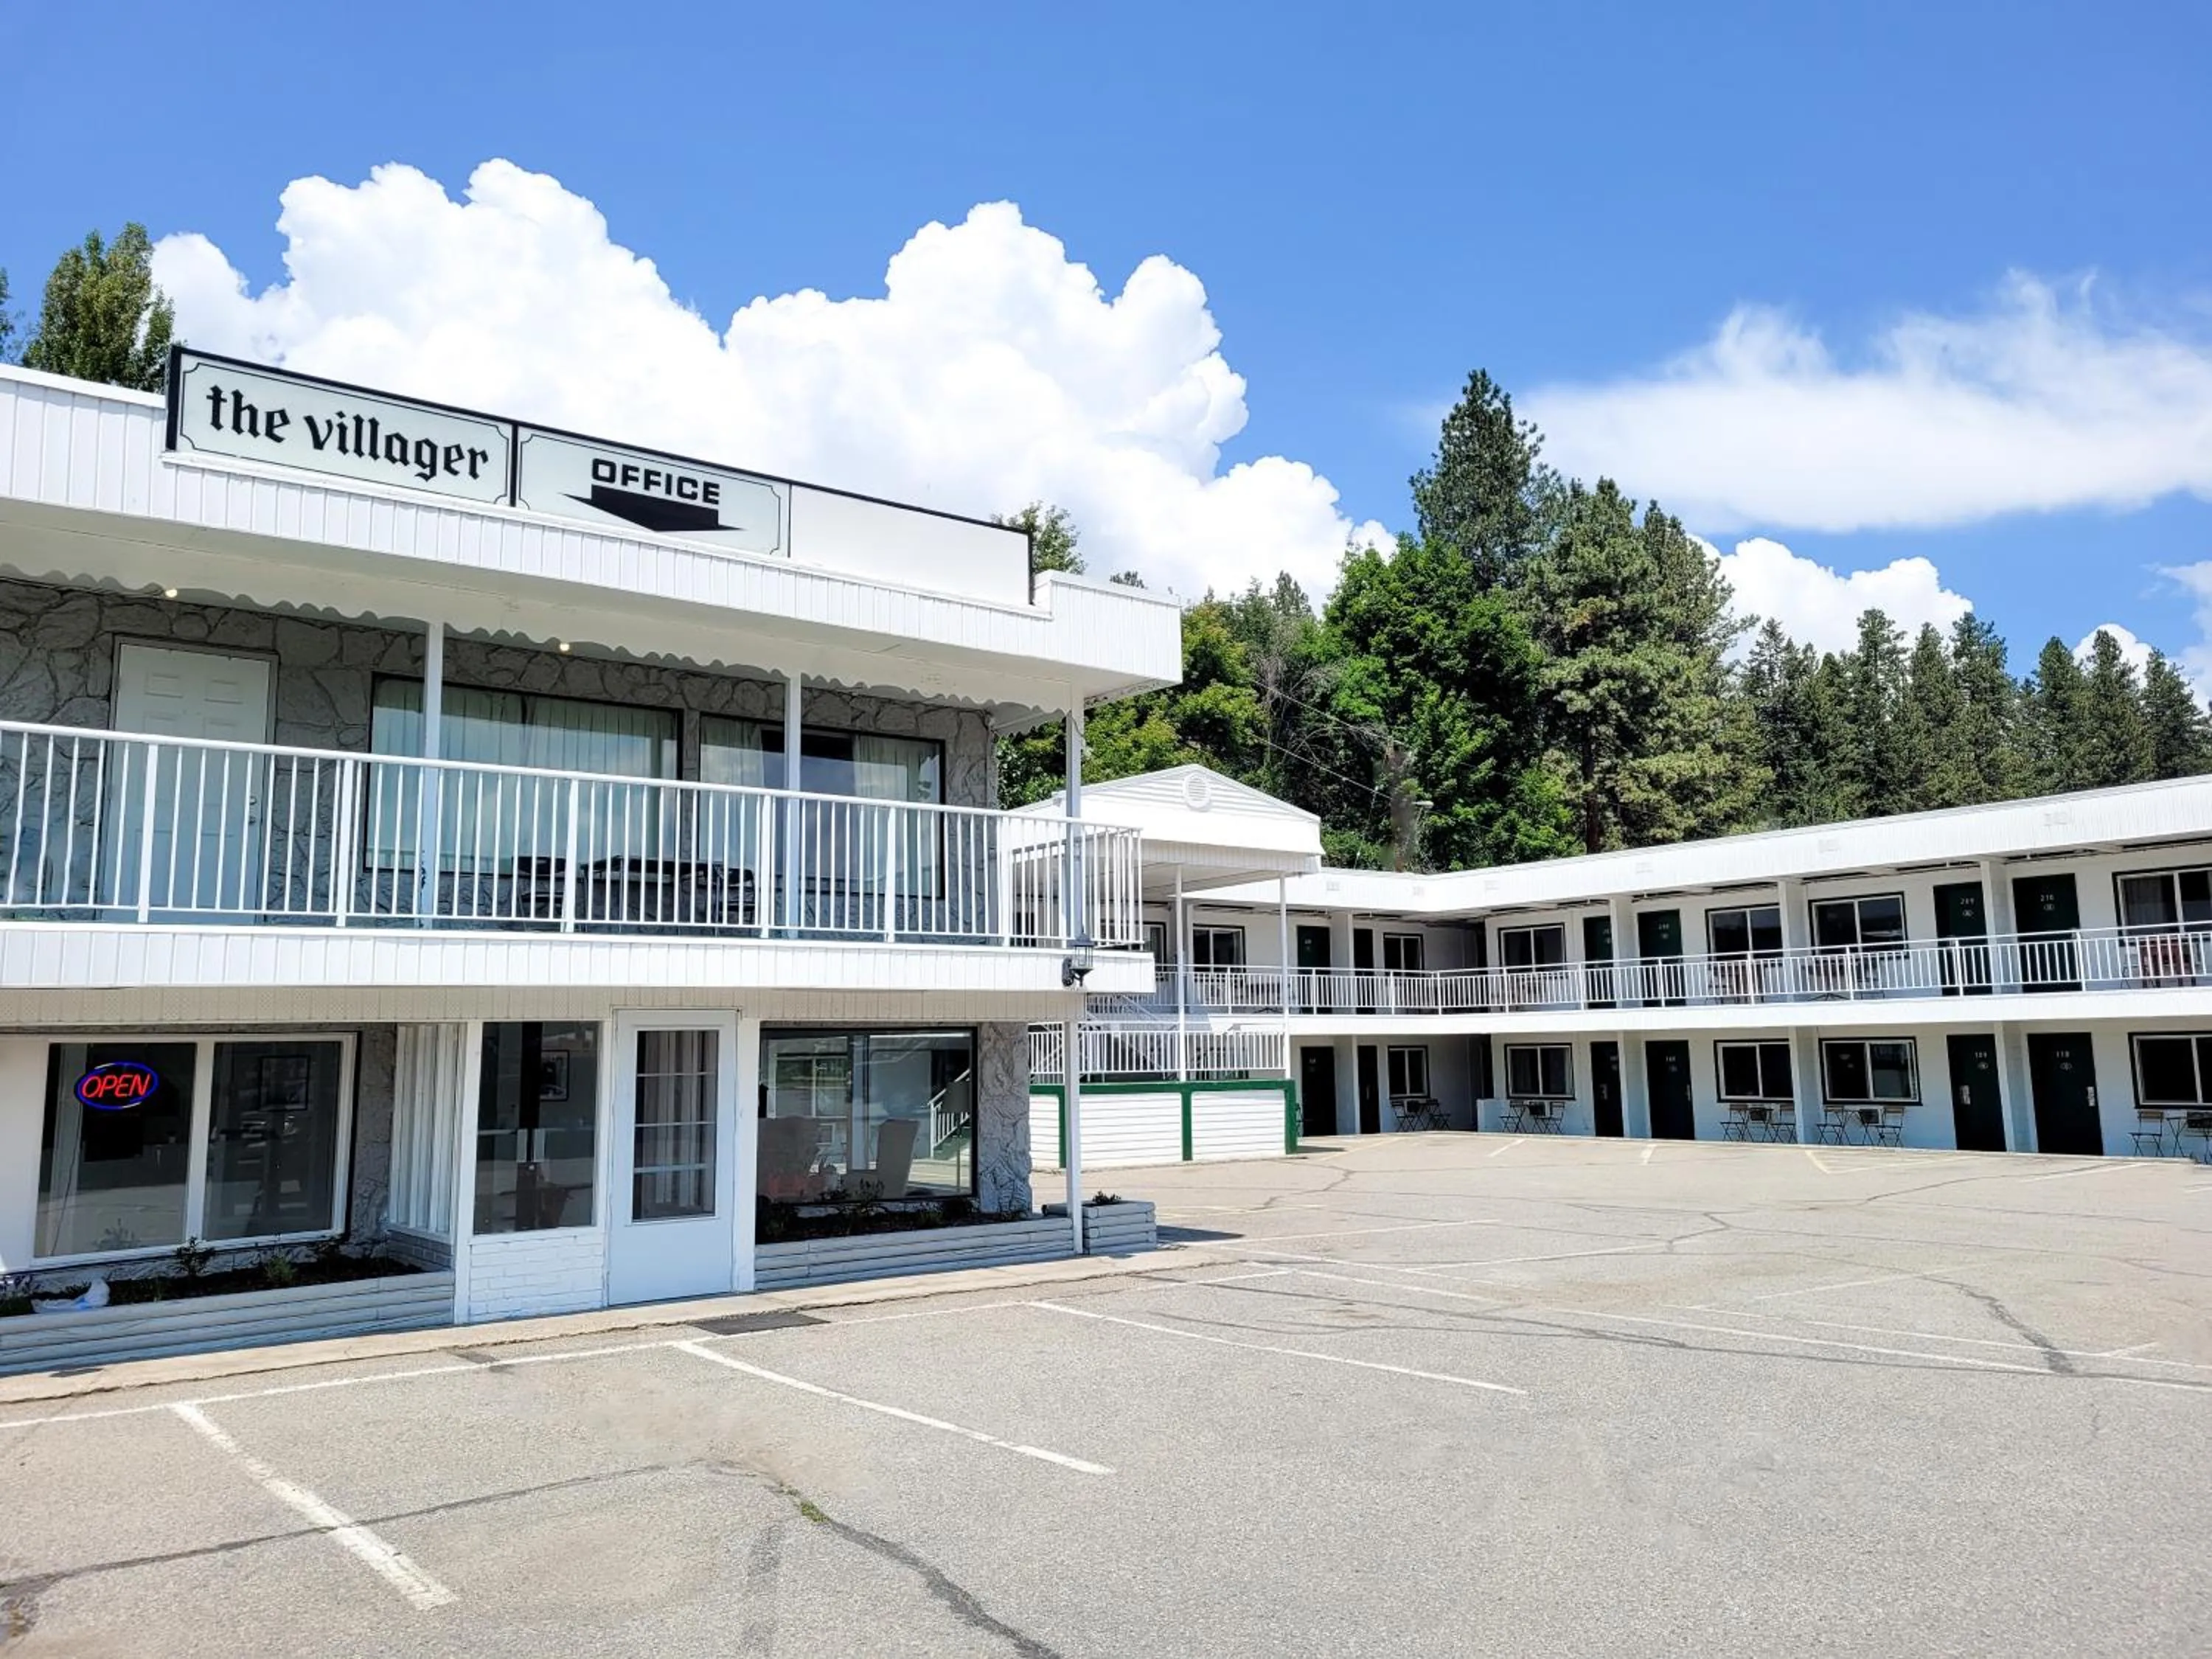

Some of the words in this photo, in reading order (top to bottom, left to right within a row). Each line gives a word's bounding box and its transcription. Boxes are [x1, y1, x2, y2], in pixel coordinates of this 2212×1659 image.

[206, 385, 291, 442] the
[303, 411, 489, 483] villager
[591, 458, 720, 506] OFFICE
[82, 1074, 151, 1098] OPEN
